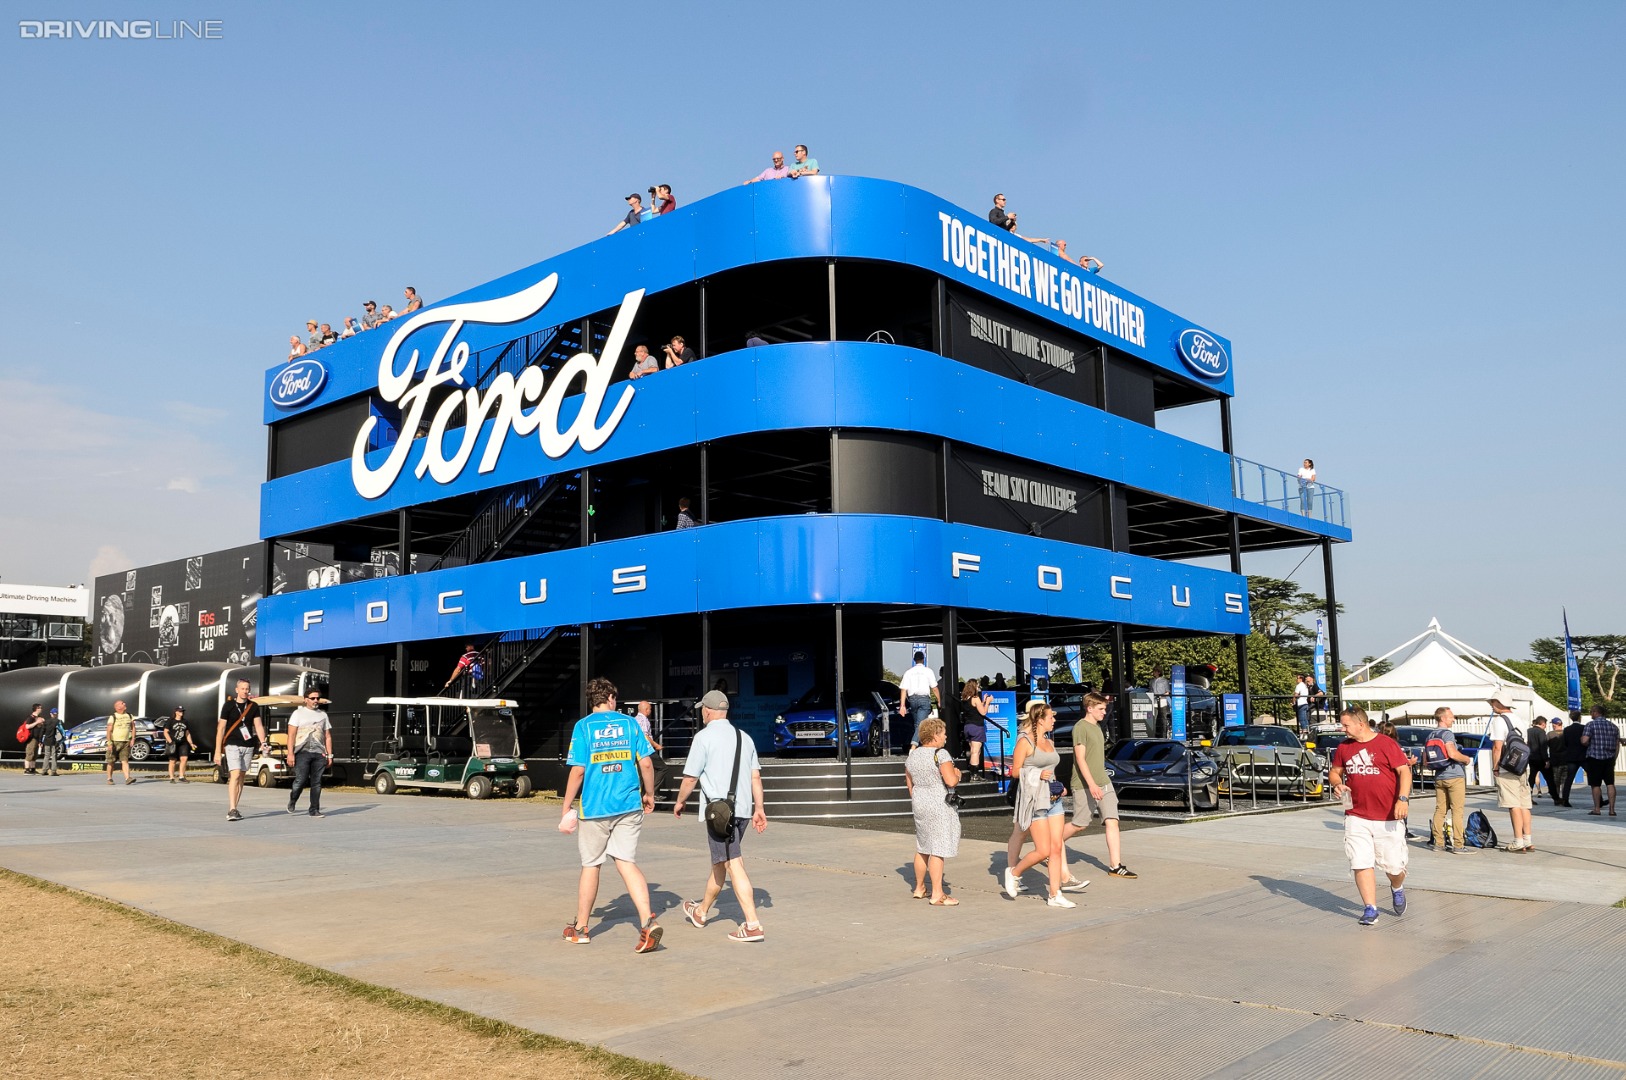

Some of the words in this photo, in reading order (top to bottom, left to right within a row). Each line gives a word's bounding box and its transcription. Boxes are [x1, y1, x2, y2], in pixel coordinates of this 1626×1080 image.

[938, 211, 1032, 299] TOGETHER
[1032, 257, 1060, 311] WE
[1060, 271, 1082, 320] GO
[1083, 281, 1146, 349] FURTHER
[1011, 328, 1040, 361] MOVIE
[1040, 340, 1076, 374] STUDIOS
[1190, 334, 1220, 370] Ford
[278, 367, 312, 397] Ford
[351, 271, 647, 501] Ford
[981, 469, 1010, 499] TEAM
[1010, 476, 1029, 503] SKY
[1029, 480, 1078, 514] CHALLENGE
[952, 552, 1243, 614] FOCUS
[26, 594, 49, 603] Driving
[50, 595, 77, 603] Machine
[303, 564, 648, 632] FOCUS
[200, 612, 215, 626] FOS
[200, 623, 229, 639] FUTURE
[200, 639, 215, 652] LAB
[410, 659, 429, 672] SHOP
[723, 660, 770, 668] FOCUS
[592, 741, 610, 749] TEAM
[593, 752, 629, 762] RENAULT
[602, 764, 615, 773] elf
